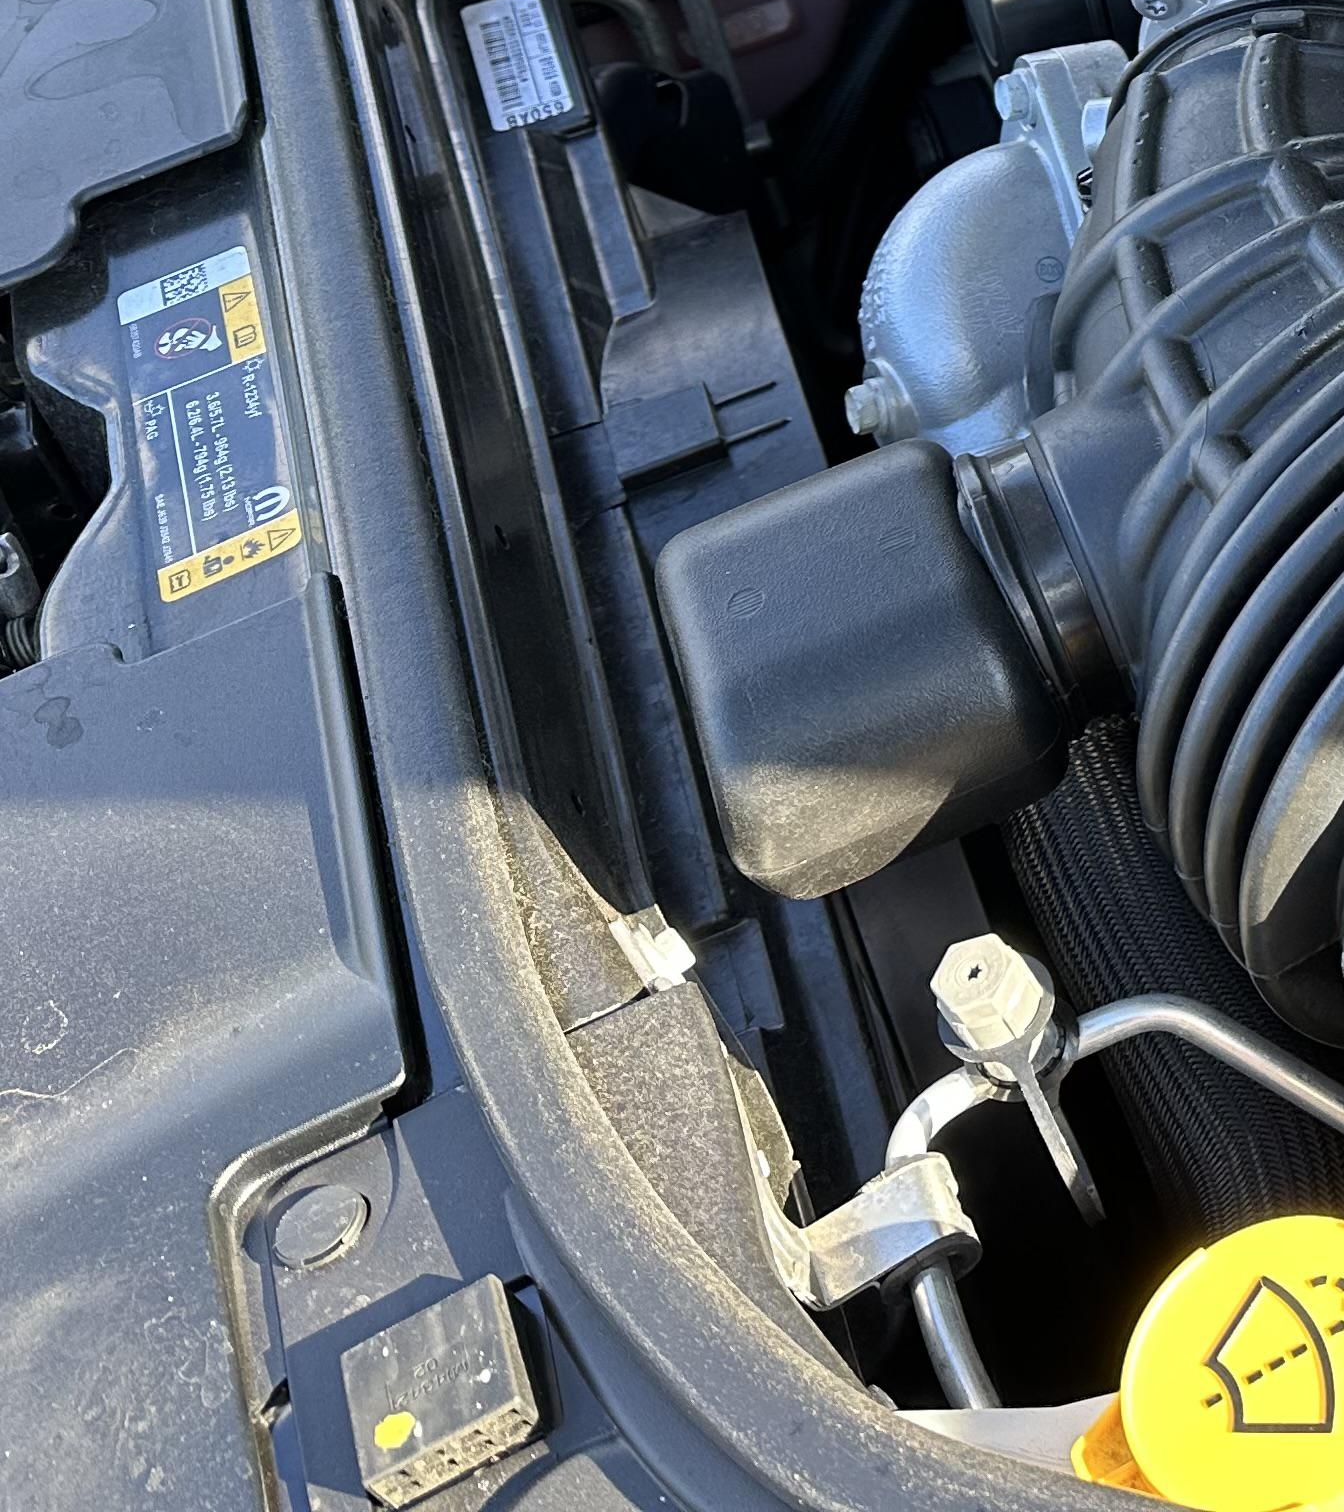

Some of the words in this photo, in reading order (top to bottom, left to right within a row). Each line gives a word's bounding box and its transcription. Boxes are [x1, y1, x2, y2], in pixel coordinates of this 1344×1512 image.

[241, 373, 263, 419] R-1234yf
[185, 400, 206, 442] 6.2/6.4L
[206, 391, 227, 433] 3.6/5.7L
[144, 418, 160, 441] PAG
[192, 445, 210, 474] 794g
[213, 436, 231, 465] 964g
[194, 472, 216, 500] (1.75
[216, 464, 237, 492] (2.13
[154, 493, 166, 509] SAE
[200, 499, 218, 522] lbs)
[222, 491, 239, 514] lbs)
